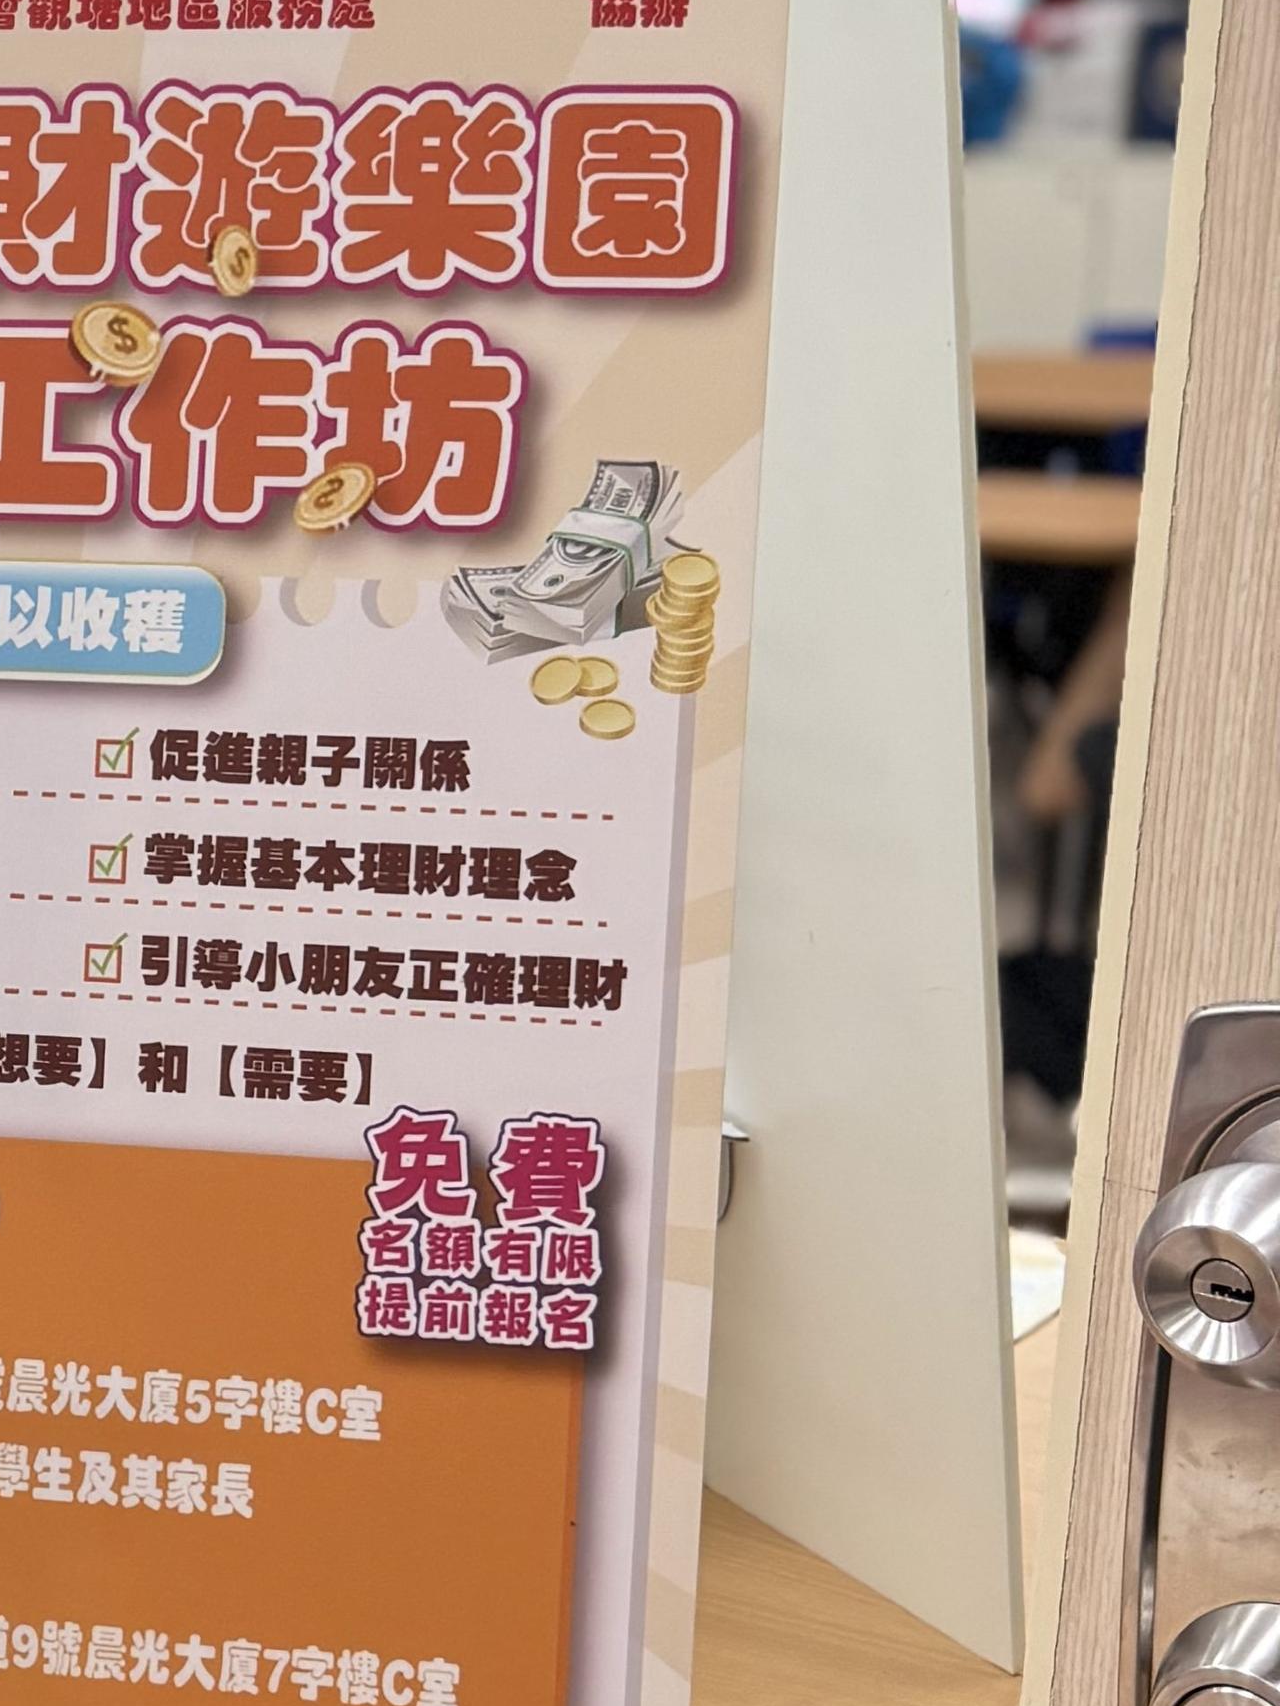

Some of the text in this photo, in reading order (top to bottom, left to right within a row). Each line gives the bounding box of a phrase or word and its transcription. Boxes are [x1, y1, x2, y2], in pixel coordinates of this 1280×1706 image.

[150, 729, 471, 792] 促進親子關係
[143, 834, 578, 903] 掌握基本理財理念
[140, 935, 627, 1012] 引導小朋友正確理財
[364, 1222, 597, 1279] 名額有限
[362, 1279, 595, 1348] 提前報名
